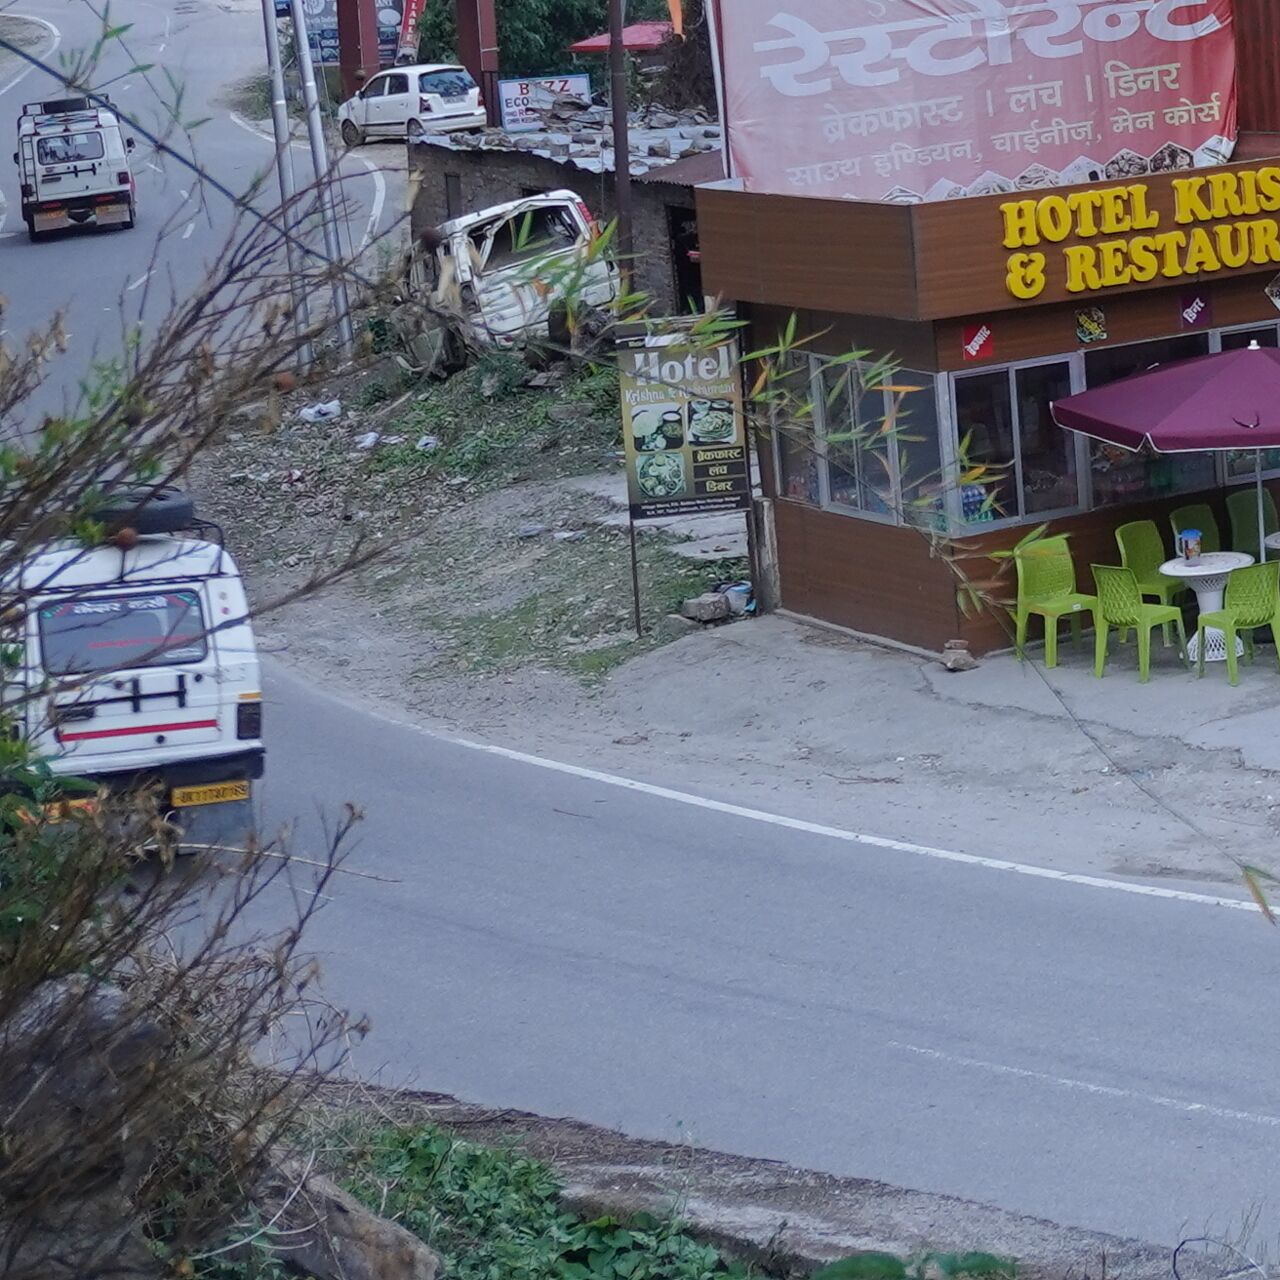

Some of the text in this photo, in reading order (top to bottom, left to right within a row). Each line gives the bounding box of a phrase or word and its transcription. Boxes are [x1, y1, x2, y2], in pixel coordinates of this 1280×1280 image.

[518, 79, 571, 96] BZZ
[1006, 74, 1064, 114] लंच
[1103, 60, 1181, 99] डिनर
[1109, 106, 1155, 135] मेन
[1163, 91, 1222, 124] कोर्स
[1000, 183, 1160, 250] HOTEL
[1005, 251, 1046, 300] &
[634, 345, 731, 386] Hotel
